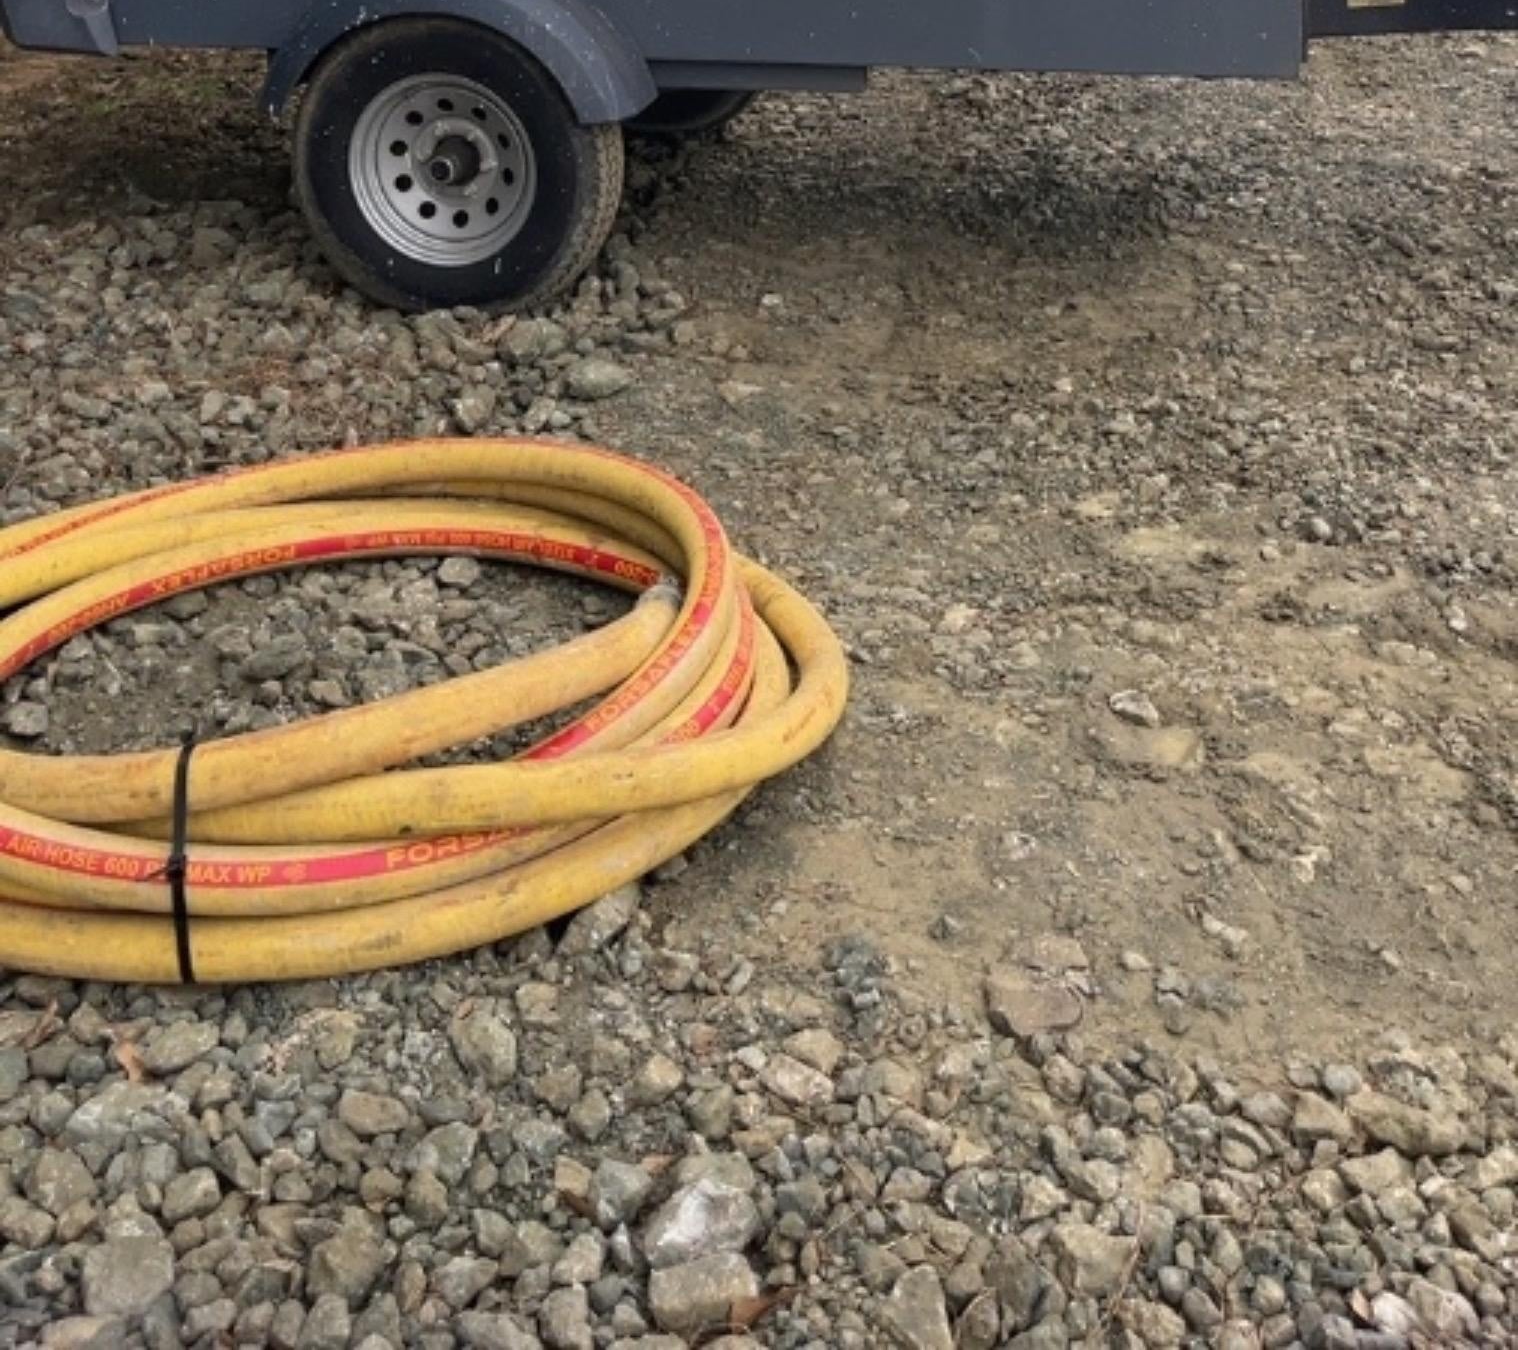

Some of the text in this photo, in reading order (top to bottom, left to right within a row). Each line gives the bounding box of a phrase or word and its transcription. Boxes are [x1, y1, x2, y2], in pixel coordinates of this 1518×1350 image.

[5, 834, 41, 858] AIR
[42, 845, 98, 872] HOSE
[103, 857, 139, 877] 600
[187, 863, 234, 883] MAX
[237, 865, 272, 883] WP
